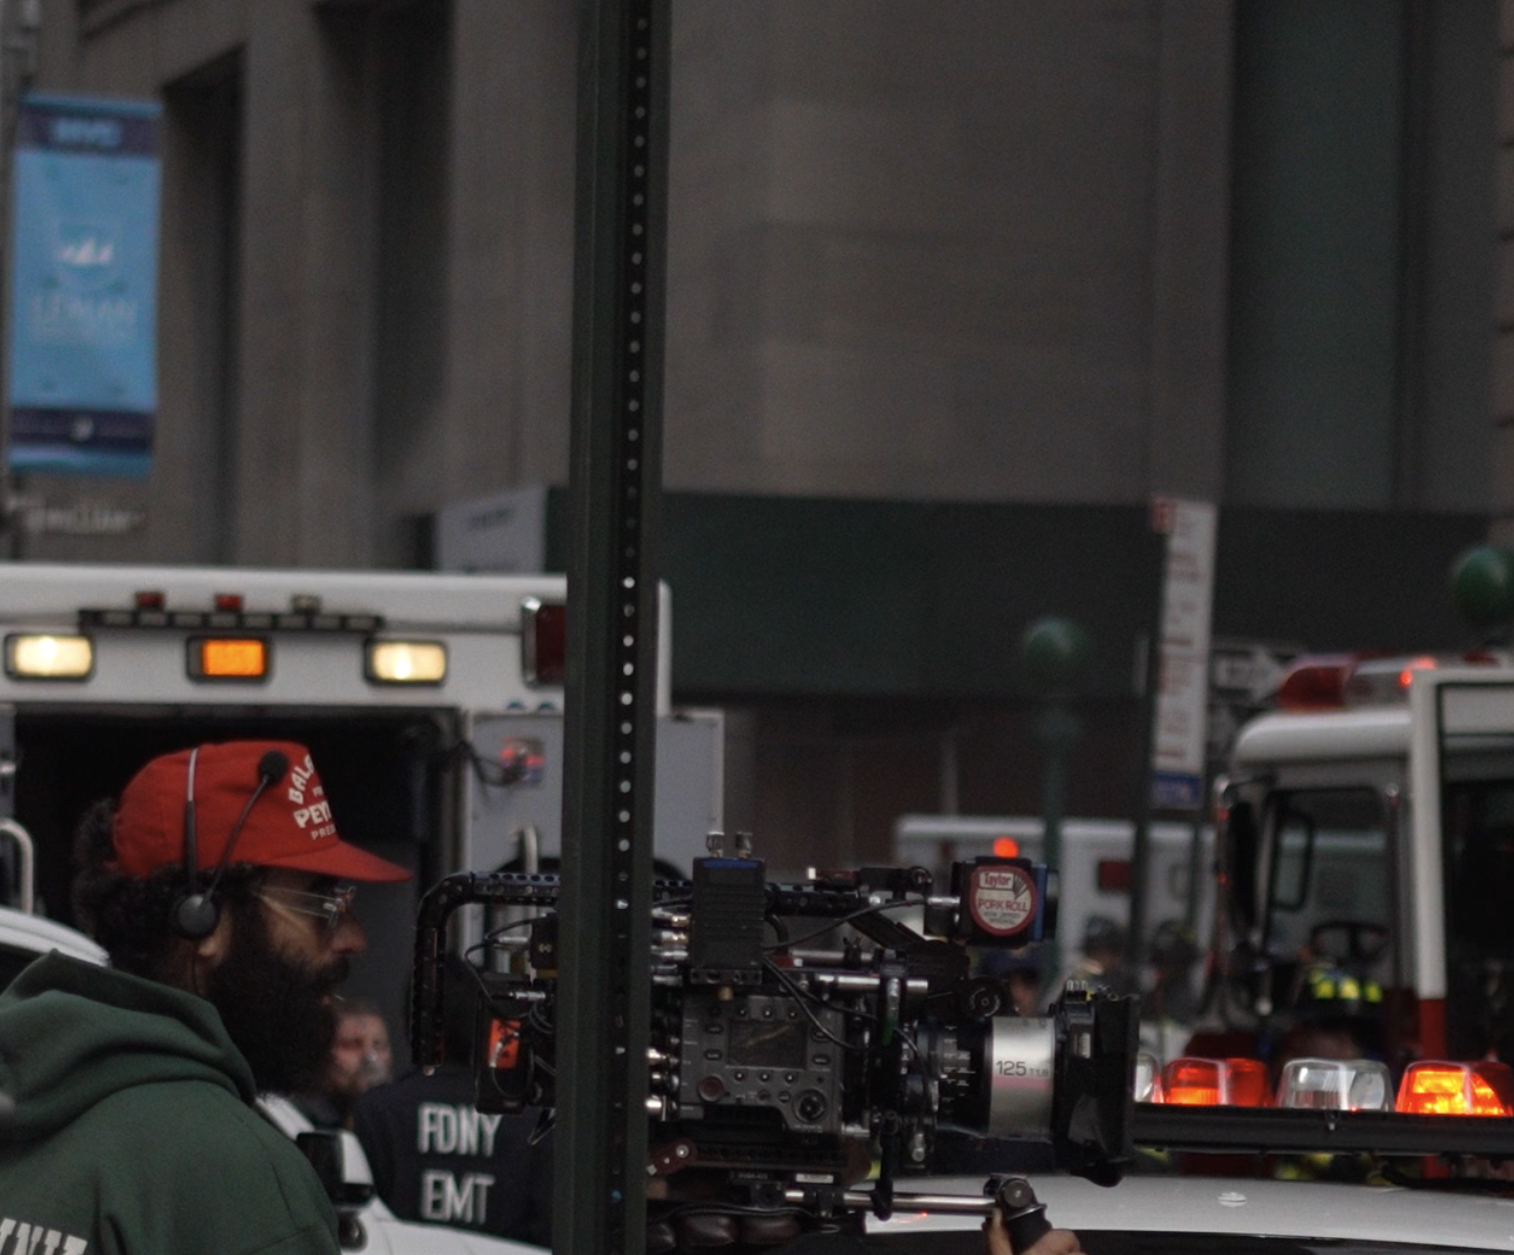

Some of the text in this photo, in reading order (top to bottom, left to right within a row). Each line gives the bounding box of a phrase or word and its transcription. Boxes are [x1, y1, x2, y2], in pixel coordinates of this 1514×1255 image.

[978, 898, 1028, 912] PORK ROLL
[996, 1060, 1027, 1077] 125
[418, 1103, 502, 1157] FDNY
[421, 1170, 494, 1224] EMT
